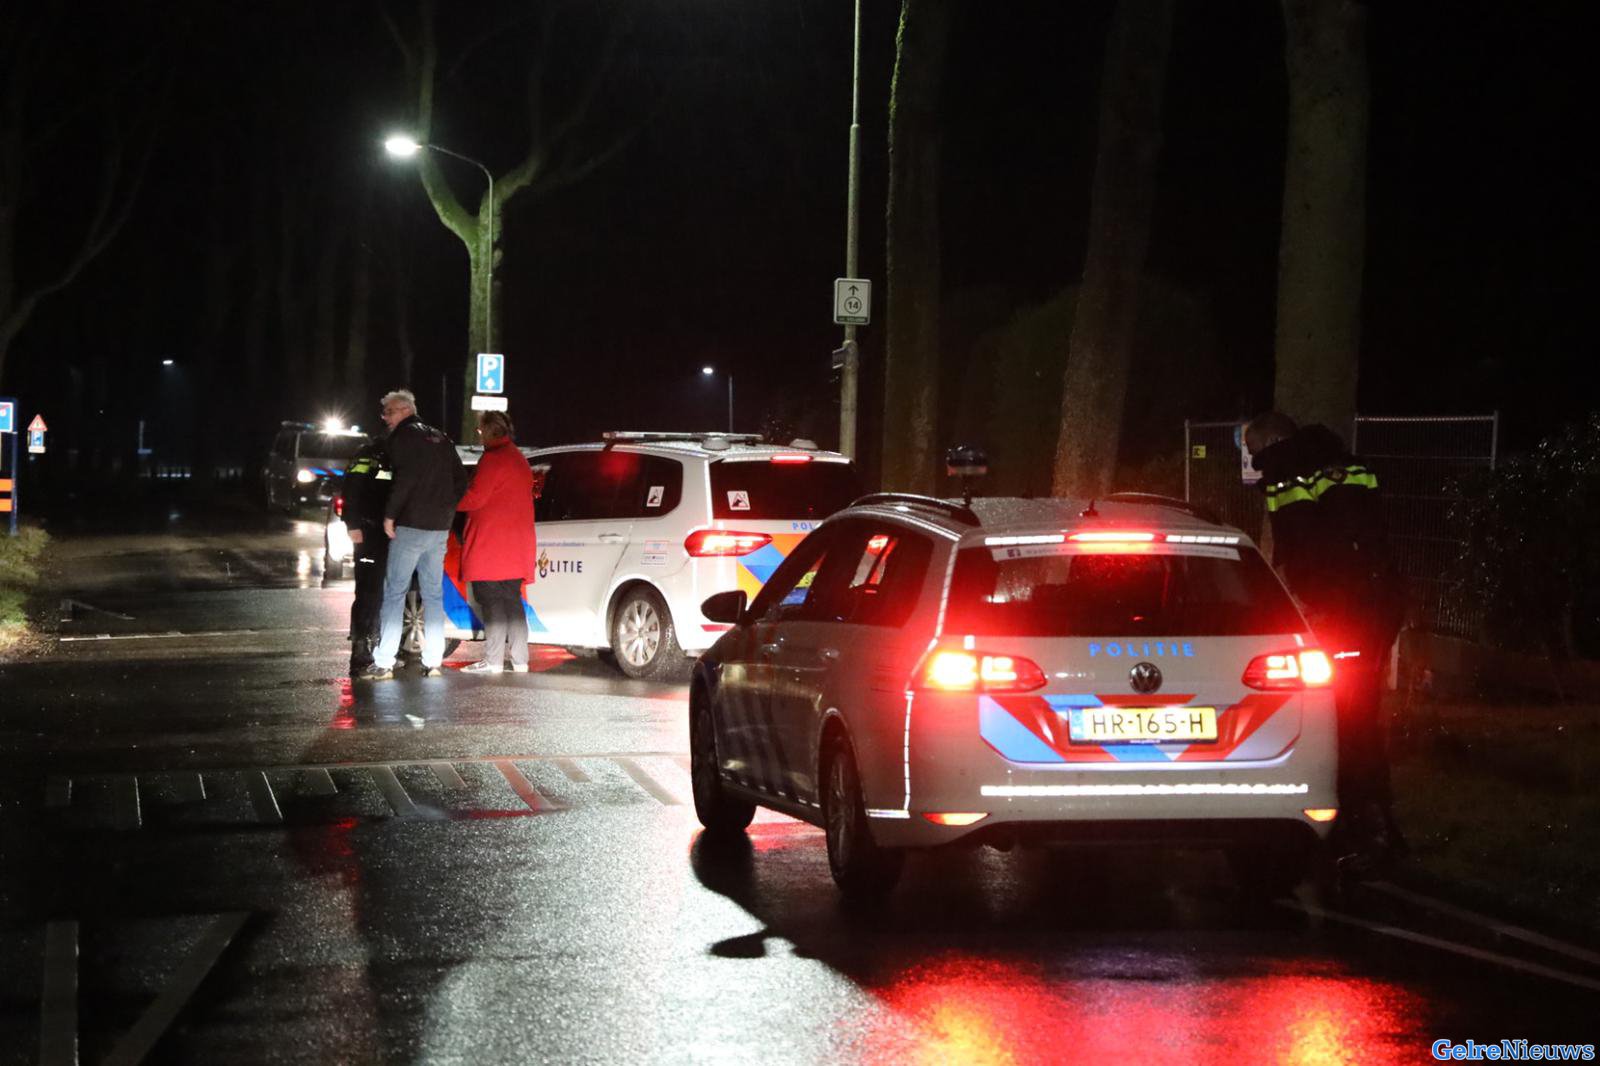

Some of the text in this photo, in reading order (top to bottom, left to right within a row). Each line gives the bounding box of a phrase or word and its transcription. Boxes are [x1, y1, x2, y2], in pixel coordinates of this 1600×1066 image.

[848, 301, 859, 310] 14
[482, 356, 498, 377] P
[1088, 641, 1196, 656] POLITIE
[1092, 713, 1204, 734] HR-165-H
